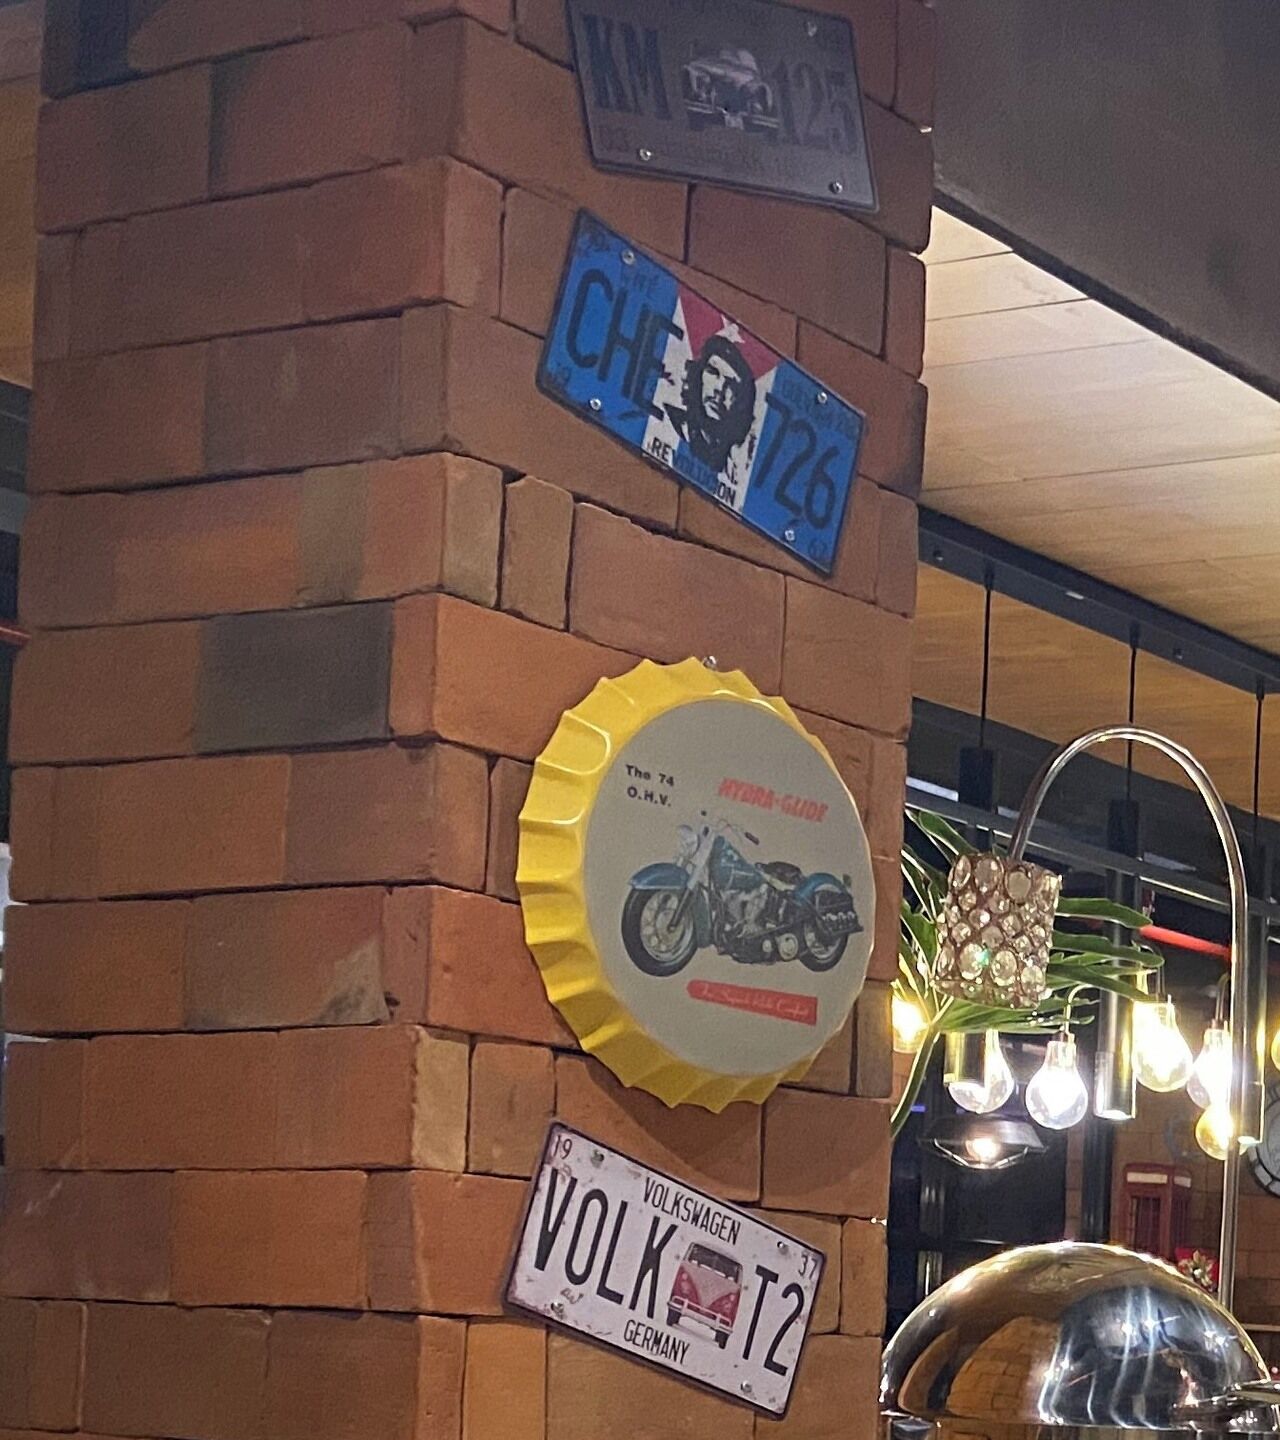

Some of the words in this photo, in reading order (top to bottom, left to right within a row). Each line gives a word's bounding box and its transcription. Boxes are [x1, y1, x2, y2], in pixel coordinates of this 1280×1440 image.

[582, 14, 673, 120] KM
[566, 268, 684, 420] CHE
[765, 391, 841, 529] 726
[625, 764, 651, 781] The
[658, 773, 675, 787] 74
[626, 786, 672, 808] O.H.V.
[718, 777, 829, 823] HYDRA-GLIDE
[553, 1135, 574, 1160] 19
[643, 1176, 741, 1246] VOLKSWAGEN
[534, 1166, 679, 1320] VOLK
[742, 1264, 805, 1377] T2
[798, 1254, 819, 1281] 37
[623, 1318, 691, 1365] GERMANY
